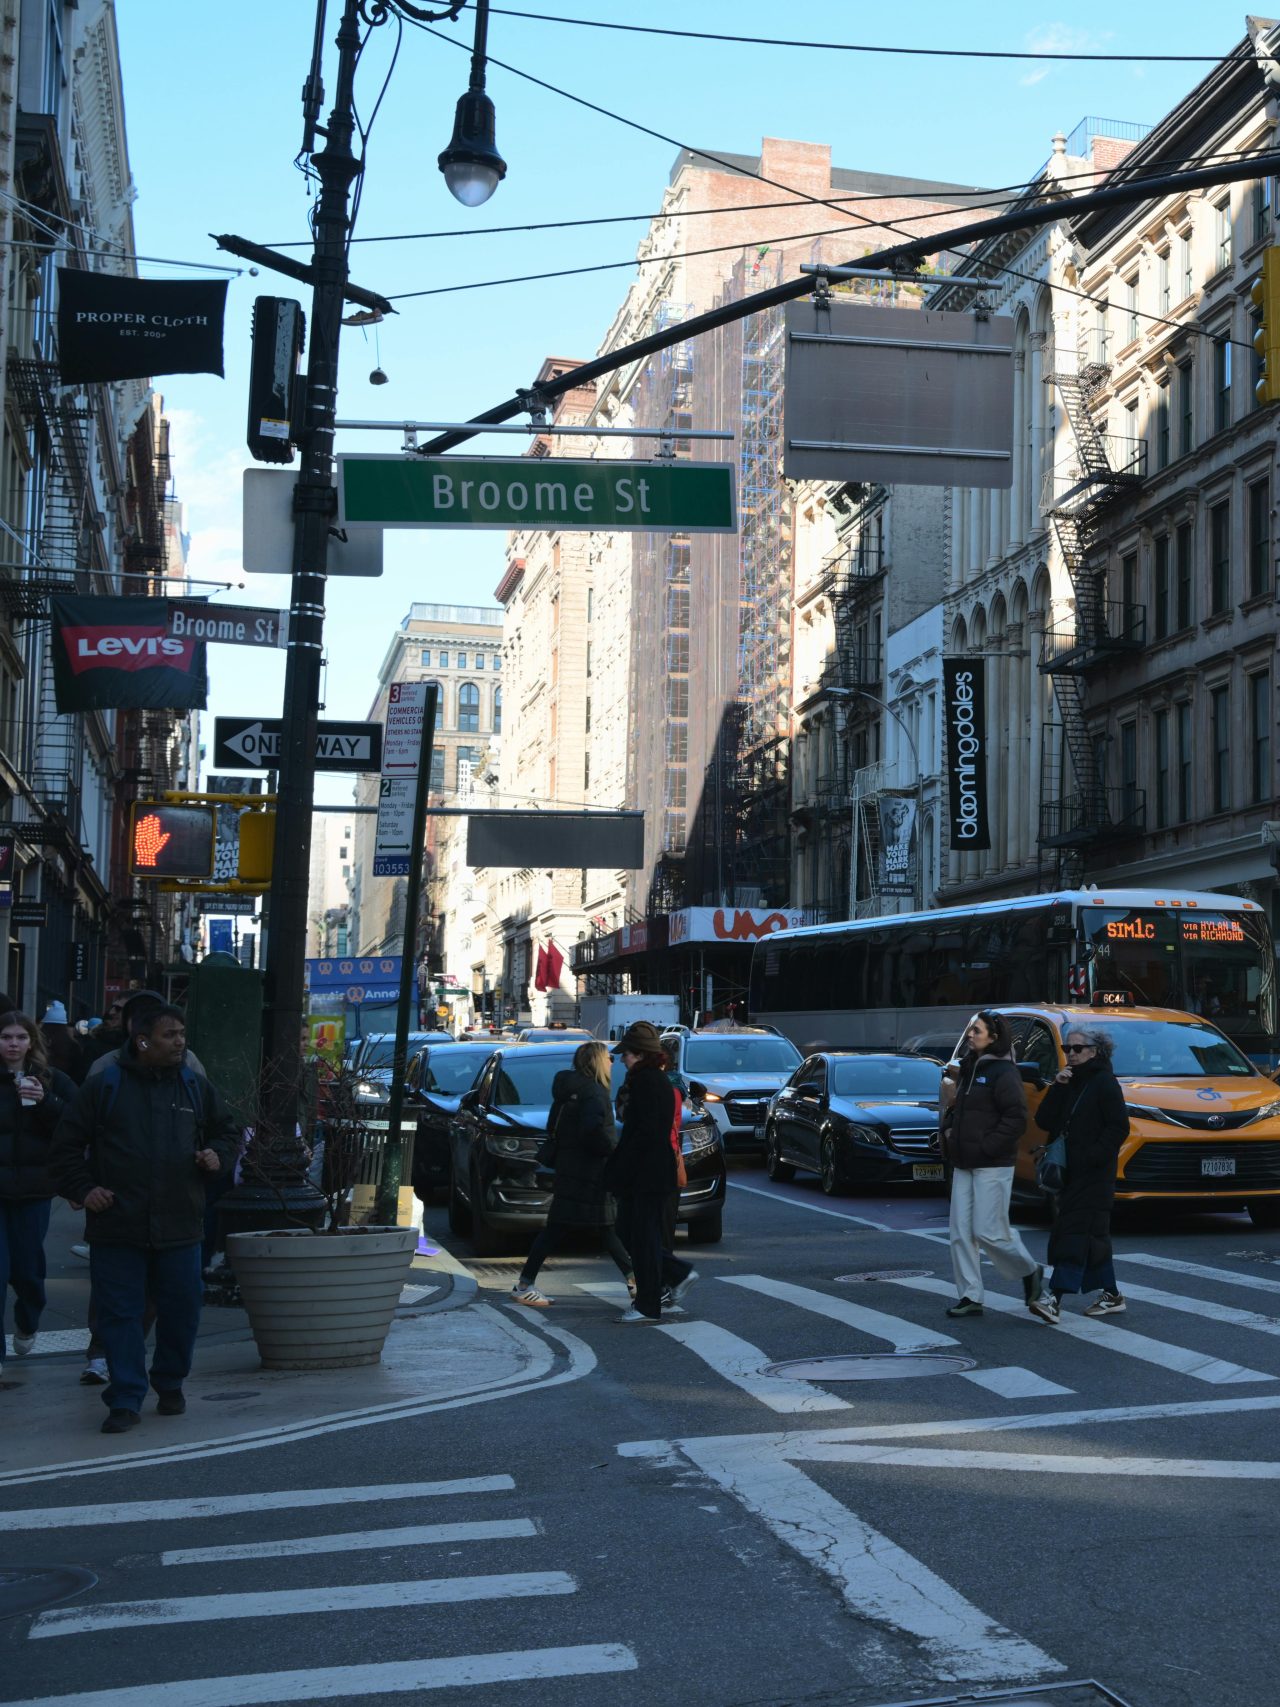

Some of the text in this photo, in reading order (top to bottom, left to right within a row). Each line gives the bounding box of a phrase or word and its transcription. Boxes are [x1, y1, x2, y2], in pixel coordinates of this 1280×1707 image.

[76, 311, 208, 327] PROPER CLOTH
[433, 474, 652, 513] Broome St
[172, 611, 275, 643] Broome St
[391, 685, 400, 702] 3
[389, 706, 425, 715] COMMERCIA
[388, 716, 416, 725] VEHICLES
[316, 736, 361, 757] WAY
[382, 779, 390, 796] 2
[887, 844, 908, 852] MAKE
[214, 851, 240, 861] YOU
[887, 850, 908, 859] YOUR
[213, 860, 239, 870] MAR
[885, 856, 909, 865] MARK
[375, 863, 410, 874] 103553
[886, 863, 908, 871] SOHO
[212, 868, 238, 880] SOH
[1183, 922, 1198, 931] VIA
[1200, 920, 1229, 931] HYLAN
[1183, 930, 1244, 941] VIA RICHMOND
[1103, 993, 1125, 1004] 6C44
